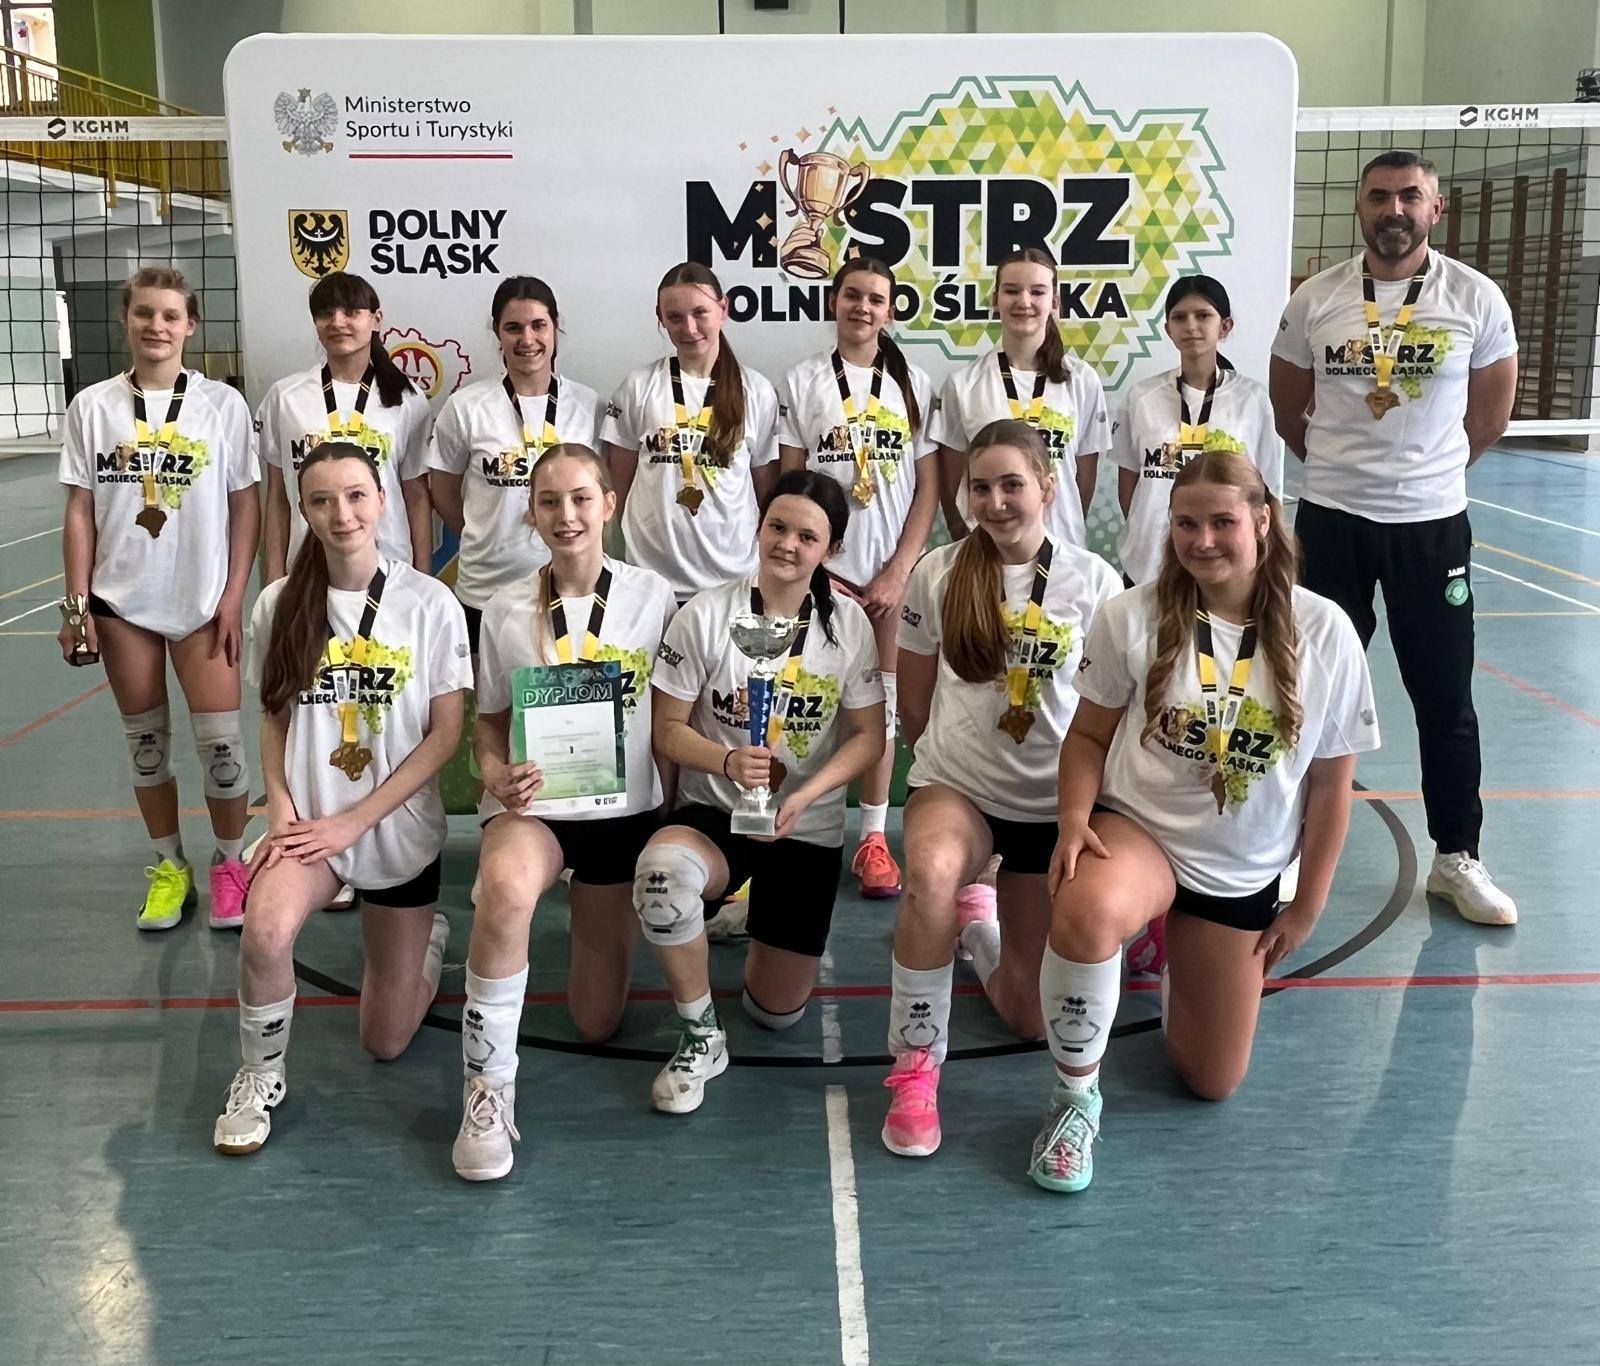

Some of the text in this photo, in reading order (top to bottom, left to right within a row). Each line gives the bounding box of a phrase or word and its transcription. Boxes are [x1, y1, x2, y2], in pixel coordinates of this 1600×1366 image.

[345, 96, 471, 113] Ministerstwo
[1484, 107, 1539, 121] KGHM
[72, 120, 129, 133] KGHM
[346, 121, 513, 141] Sportu i Turystyki
[369, 209, 507, 240] DOLNY
[686, 178, 1130, 269] MSTRZ
[370, 237, 500, 279] ŚLĄSK
[727, 273, 1128, 322] OLNO ŚLKA
[1325, 344, 1435, 365] MSRZ
[1390, 365, 1434, 378] LĄSKA
[97, 451, 194, 474] MSRZ
[155, 475, 192, 487] LĄSKA
[1143, 470, 1177, 480] DOLNE
[522, 682, 614, 707] DYPLOM
[782, 721, 822, 735] LĄSKA
